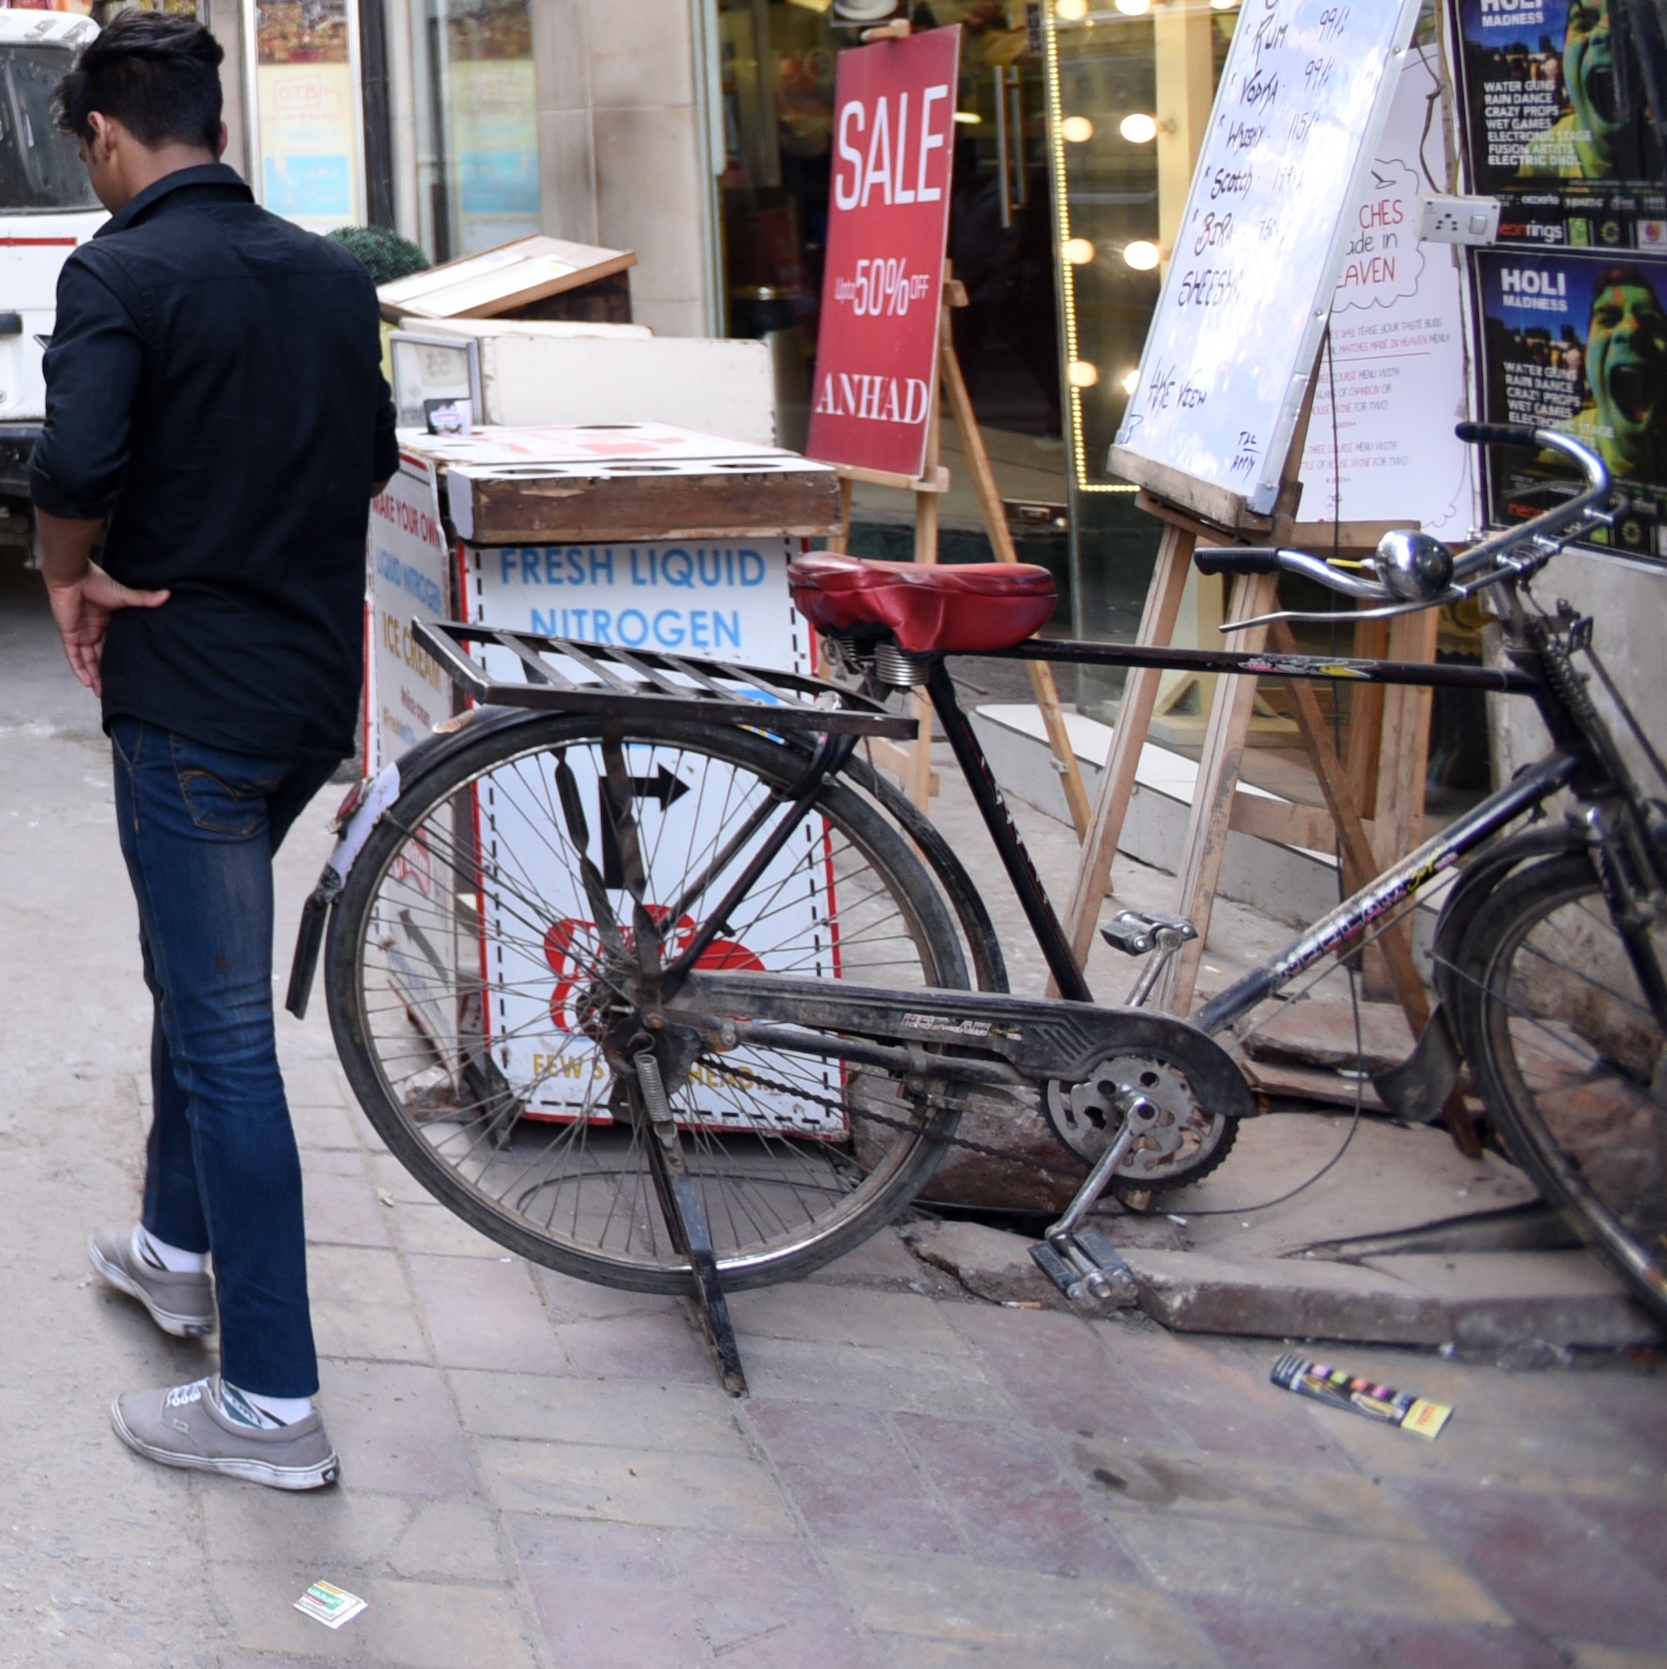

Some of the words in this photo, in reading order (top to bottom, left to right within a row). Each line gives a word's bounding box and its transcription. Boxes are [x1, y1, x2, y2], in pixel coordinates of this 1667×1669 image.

[1482, 11, 1544, 28] MADNESS
[1484, 81, 1522, 93] WATER
[1524, 80, 1556, 92] GUNS
[1484, 93, 1513, 106] RAIN
[1513, 92, 1553, 105] DANCE
[1485, 106, 1521, 117] CRAZY
[1523, 104, 1559, 116] PROPS
[1485, 118, 1510, 129] WET
[1512, 117, 1552, 129] GAMES
[1487, 130, 1555, 142] ELECTRONIC
[834, 84, 949, 212] SALE
[1488, 143, 1530, 155] FUSION
[1487, 154, 1547, 166] ELECTRIC
[1209, 168, 1255, 200] Scotch
[1381, 232, 1398, 250] in
[835, 277, 856, 301] Upto
[853, 257, 909, 318] 50%
[910, 274, 930, 300] OFF
[1501, 268, 1566, 297] HOLI
[1503, 295, 1568, 313] MADNESS
[1502, 361, 1542, 376] WATER
[1544, 366, 1578, 381] GUNS
[1504, 373, 1533, 389] RAIN
[1534, 378, 1574, 394] DANCE
[815, 372, 929, 426] ANHAD
[1506, 386, 1540, 402] CRAZY
[1543, 391, 1581, 407] PROPS
[1508, 399, 1533, 414] WET
[372, 496, 395, 526] MAKE
[396, 499, 420, 535] YOUR
[419, 516, 441, 551] OWN
[500, 546, 615, 584] FRESH
[630, 547, 766, 589] LIQUID
[376, 547, 401, 587] LIQUID
[402, 560, 443, 616] NITROGEN
[382, 611, 401, 661] ICE
[530, 608, 741, 649] NITROGEN
[533, 1053, 583, 1080] FEW
